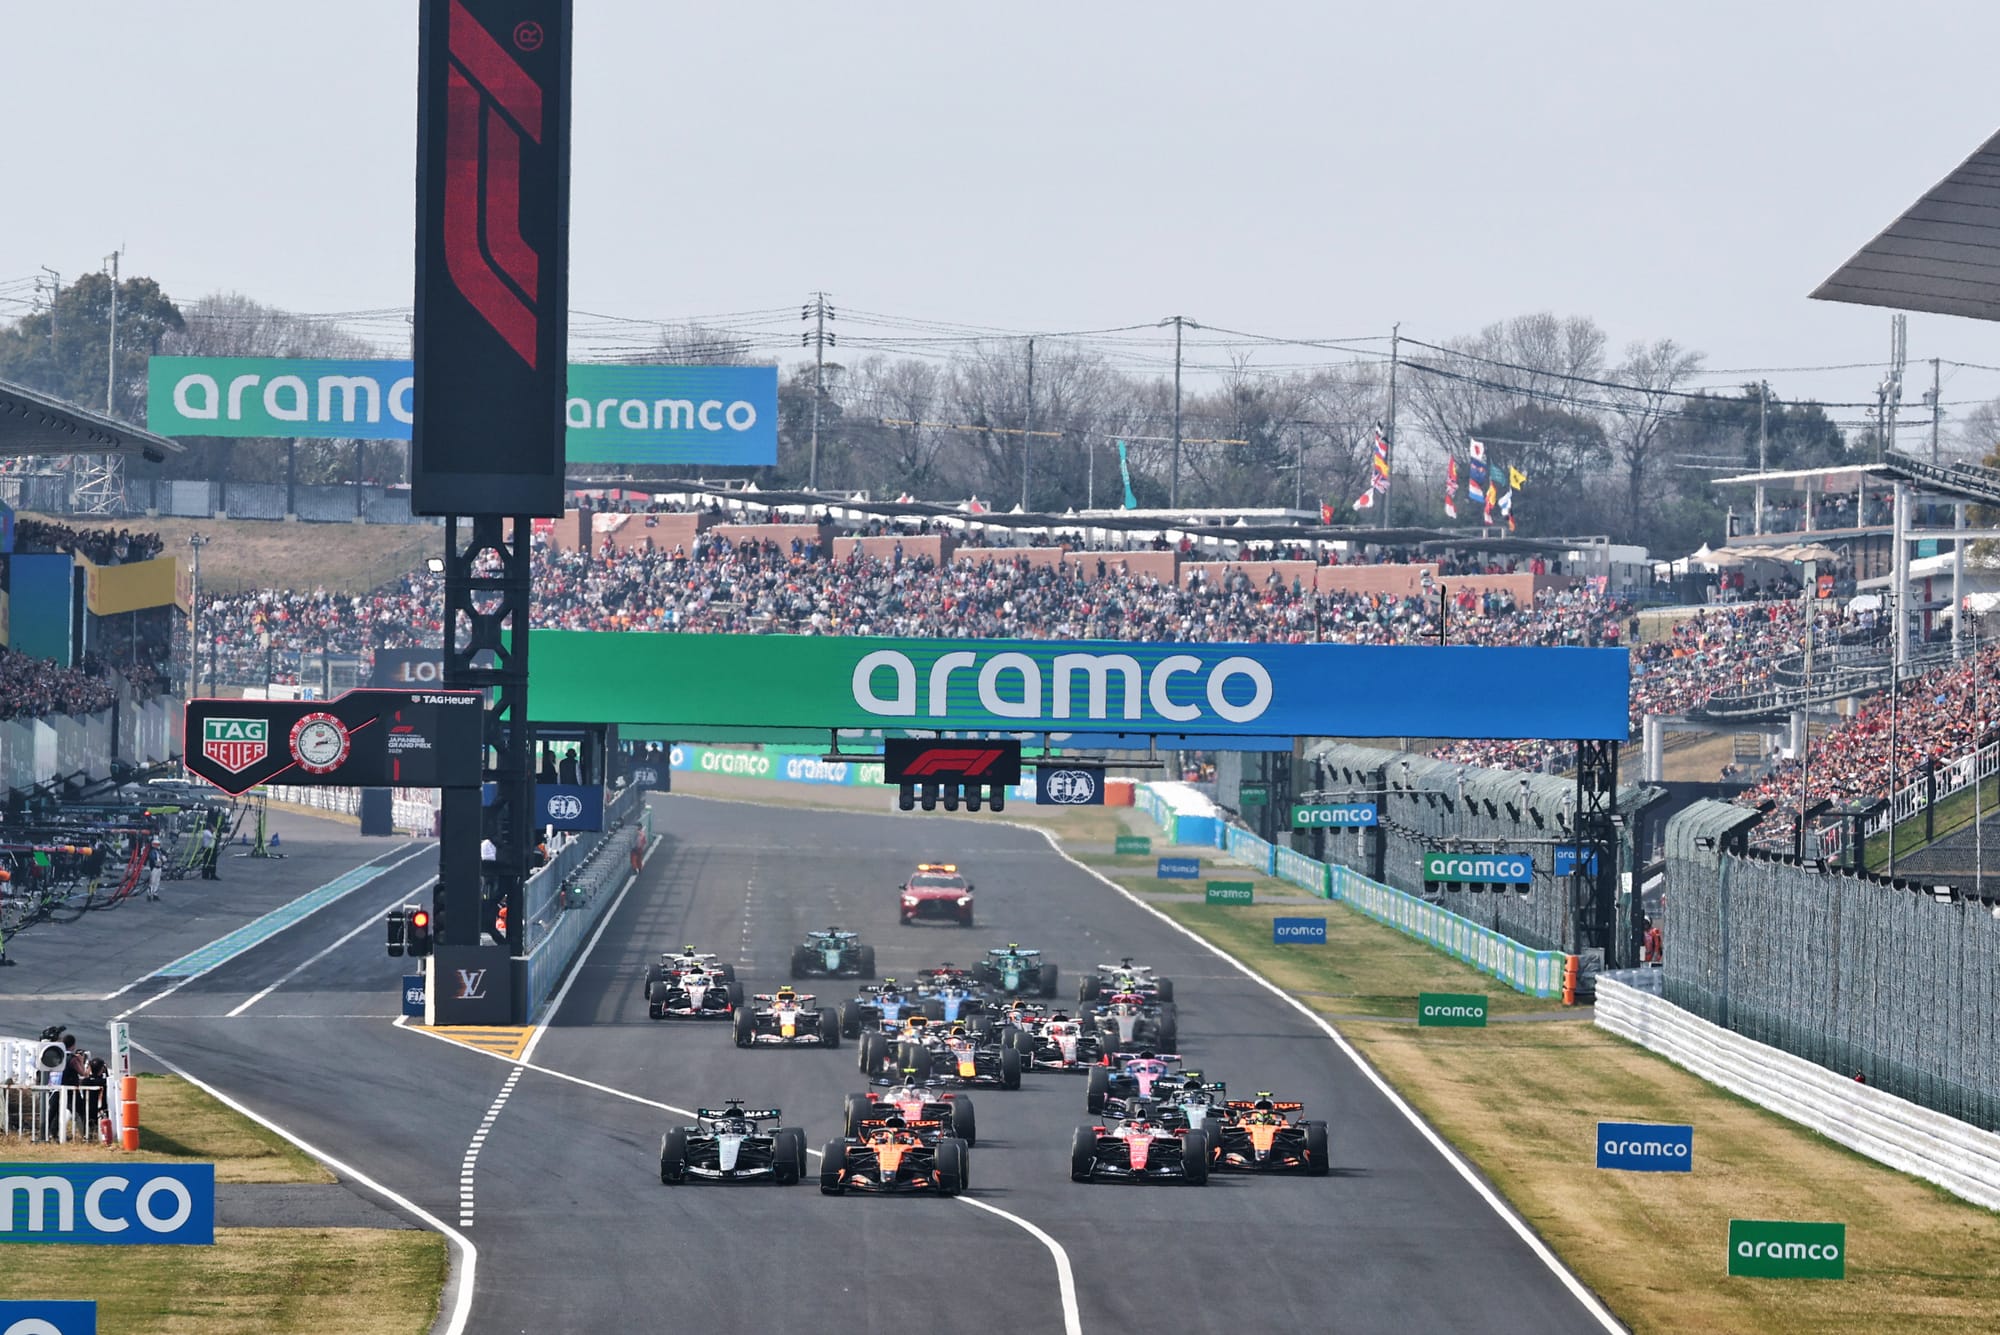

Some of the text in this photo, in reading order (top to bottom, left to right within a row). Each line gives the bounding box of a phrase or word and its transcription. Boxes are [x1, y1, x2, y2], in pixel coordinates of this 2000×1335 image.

[566, 397, 757, 432] aramco
[852, 649, 1273, 723] aramco
[208, 721, 262, 739] TAG
[207, 742, 264, 771] HEUER
[701, 751, 770, 775] aramco
[787, 758, 848, 782] aramco
[1297, 808, 1373, 823] aramco
[1430, 859, 1525, 877] aramco
[1277, 925, 1324, 937] aramco
[1424, 1004, 1484, 1018] aramco
[1604, 1140, 1688, 1157] aramco
[1737, 1240, 1839, 1261] aramco
